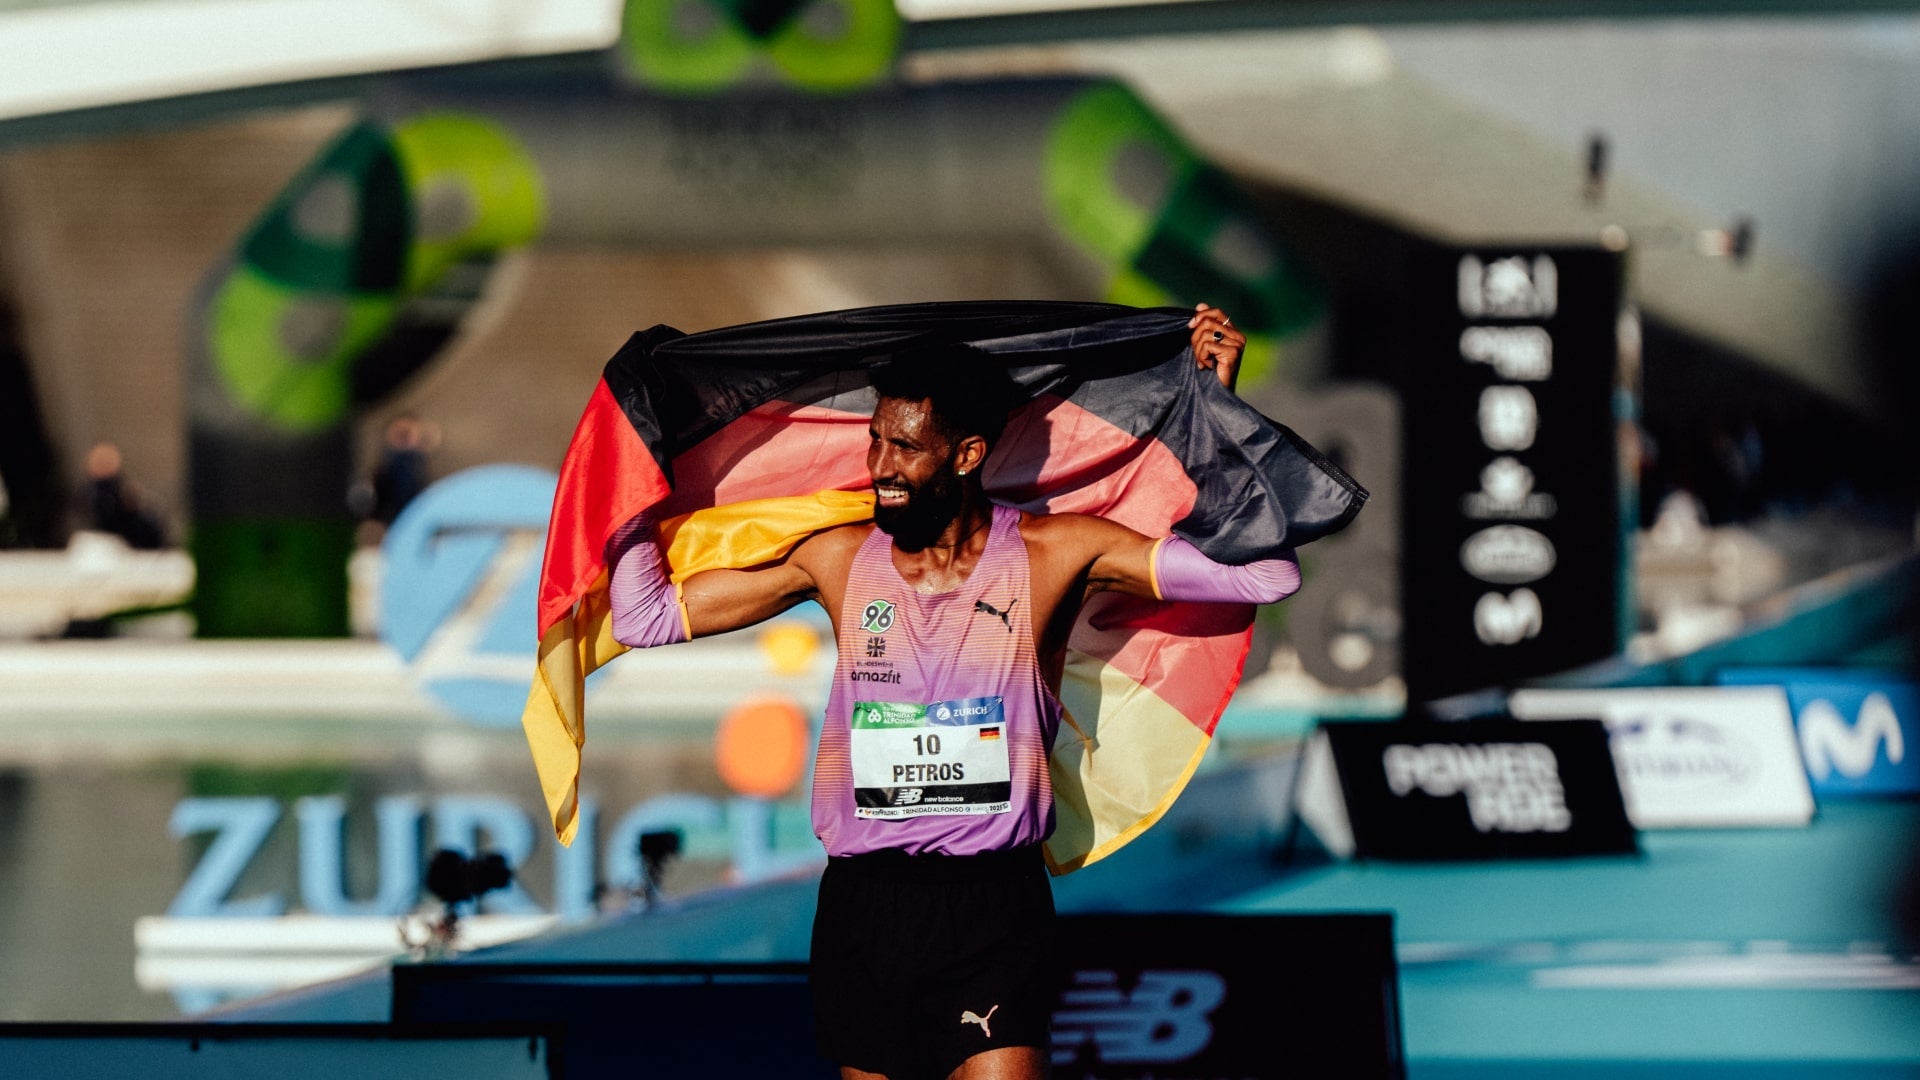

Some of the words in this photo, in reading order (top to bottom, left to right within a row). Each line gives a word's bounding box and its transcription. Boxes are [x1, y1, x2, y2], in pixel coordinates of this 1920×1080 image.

[863, 604, 896, 629] 96
[851, 670, 901, 684] amazfit
[953, 706, 988, 717] ZURICH
[913, 734, 941, 756] 10
[893, 763, 965, 782] PETROS
[1383, 742, 1559, 796] POWER
[894, 788, 924, 805] NB
